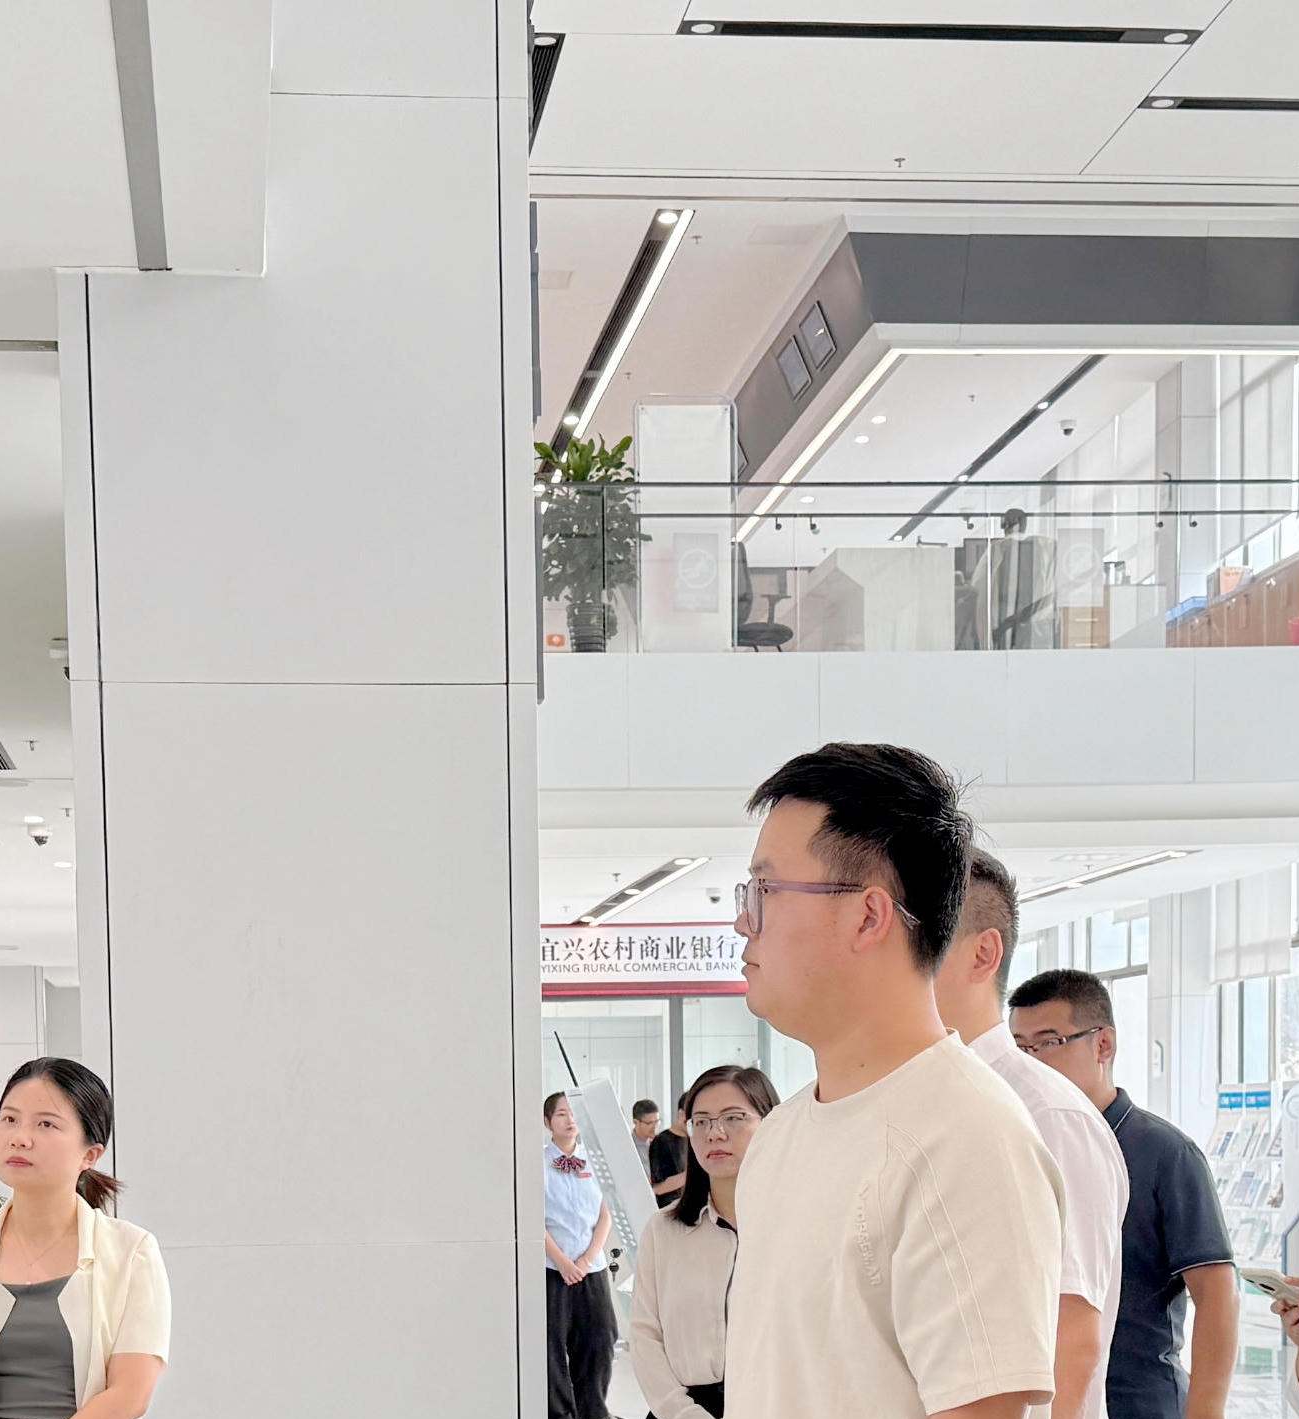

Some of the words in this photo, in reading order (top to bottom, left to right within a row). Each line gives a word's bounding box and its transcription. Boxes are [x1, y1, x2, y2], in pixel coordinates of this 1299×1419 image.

[541, 935, 739, 962] 宜兴农村商业银行
[541, 963, 580, 974] YIXING
[583, 963, 620, 973] RURAL
[623, 961, 702, 973] COMMERCIAL
[706, 961, 738, 972] BANK
